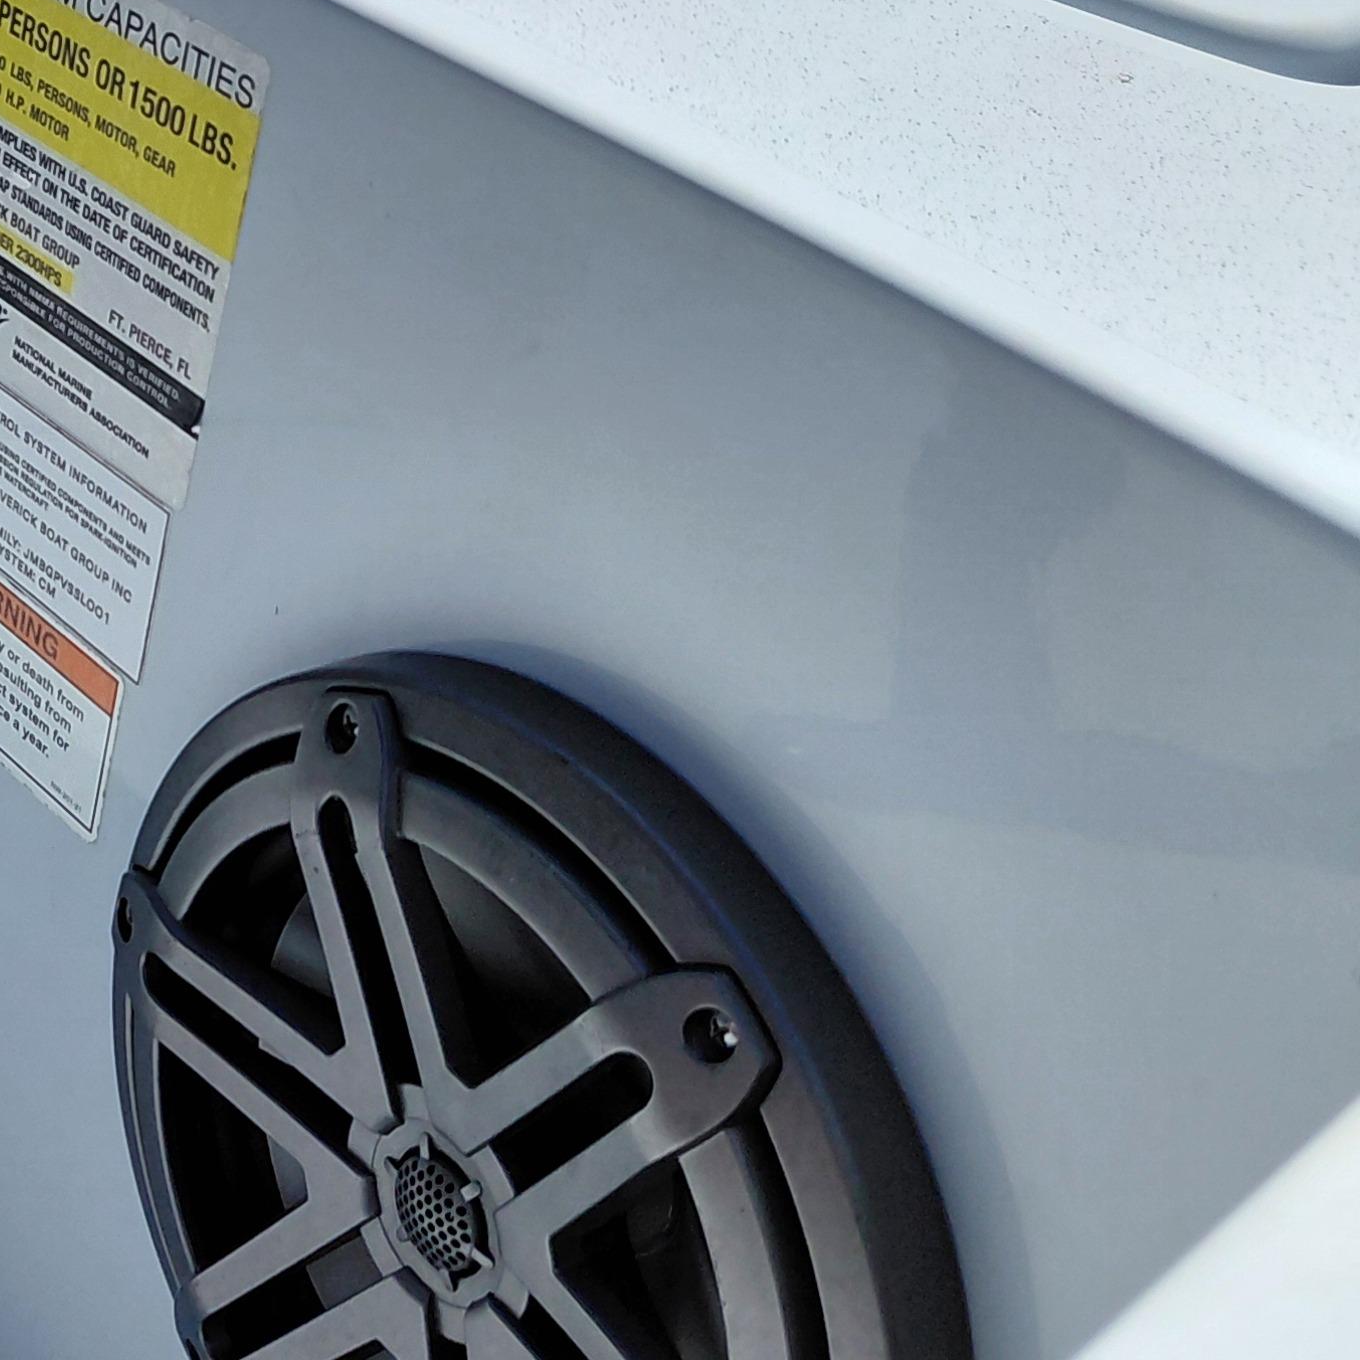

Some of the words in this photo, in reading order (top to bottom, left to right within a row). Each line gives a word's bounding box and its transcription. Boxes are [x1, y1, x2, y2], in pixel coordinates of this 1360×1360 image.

[5, 88, 27, 115] H.P.
[29, 103, 70, 142] MOTOR
[9, 61, 35, 91] LBS,
[35, 78, 92, 128] PERSONS,
[93, 113, 141, 159] MOTOR,
[142, 143, 176, 178] GEAR
[93, 56, 127, 102] OR
[125, 76, 187, 138] 1500
[187, 112, 241, 171] LBS.
[2, 150, 41, 188] EFFECT
[41, 176, 58, 200] ON
[58, 187, 81, 214] THE
[81, 202, 111, 235] DATE
[111, 222, 128, 246] OF
[128, 234, 215, 304] CERTIFICATION
[9, 210, 40, 244] BOAT
[41, 232, 80, 272] GROUP
[10, 183, 64, 232] STANDARDS
[63, 219, 93, 251] USING
[93, 239, 141, 284] CERTIFIED
[37, 151, 66, 182] WITH
[66, 169, 89, 197] U.S.
[89, 184, 129, 223] COAST
[129, 210, 172, 251] GUARD
[171, 238, 219, 282] SAFETY
[14, 243, 63, 289] 2300HPS
[13, 334, 57, 375] NATIONAL
[57, 366, 93, 401] MARINE
[107, 307, 127, 334] FT.
[127, 322, 175, 370] PIERCE,
[176, 356, 193, 381] FL
[11, 348, 88, 413] MANUFACTURERS
[88, 405, 149, 460] ASSOCIATION
[22, 429, 67, 473] SYSTEM
[67, 464, 148, 535] INFORMATION
[37, 575, 56, 600] CM
[38, 519, 68, 553] BOAT
[69, 544, 109, 586] GROUP
[110, 577, 132, 604] INC
[6, 646, 20, 667] or
[21, 656, 55, 697] death
[55, 686, 85, 723] from
[7, 689, 50, 740] system
[51, 726, 70, 754] for
[43, 698, 73, 735] from
[11, 716, 20, 732] a
[21, 725, 50, 762] year.
